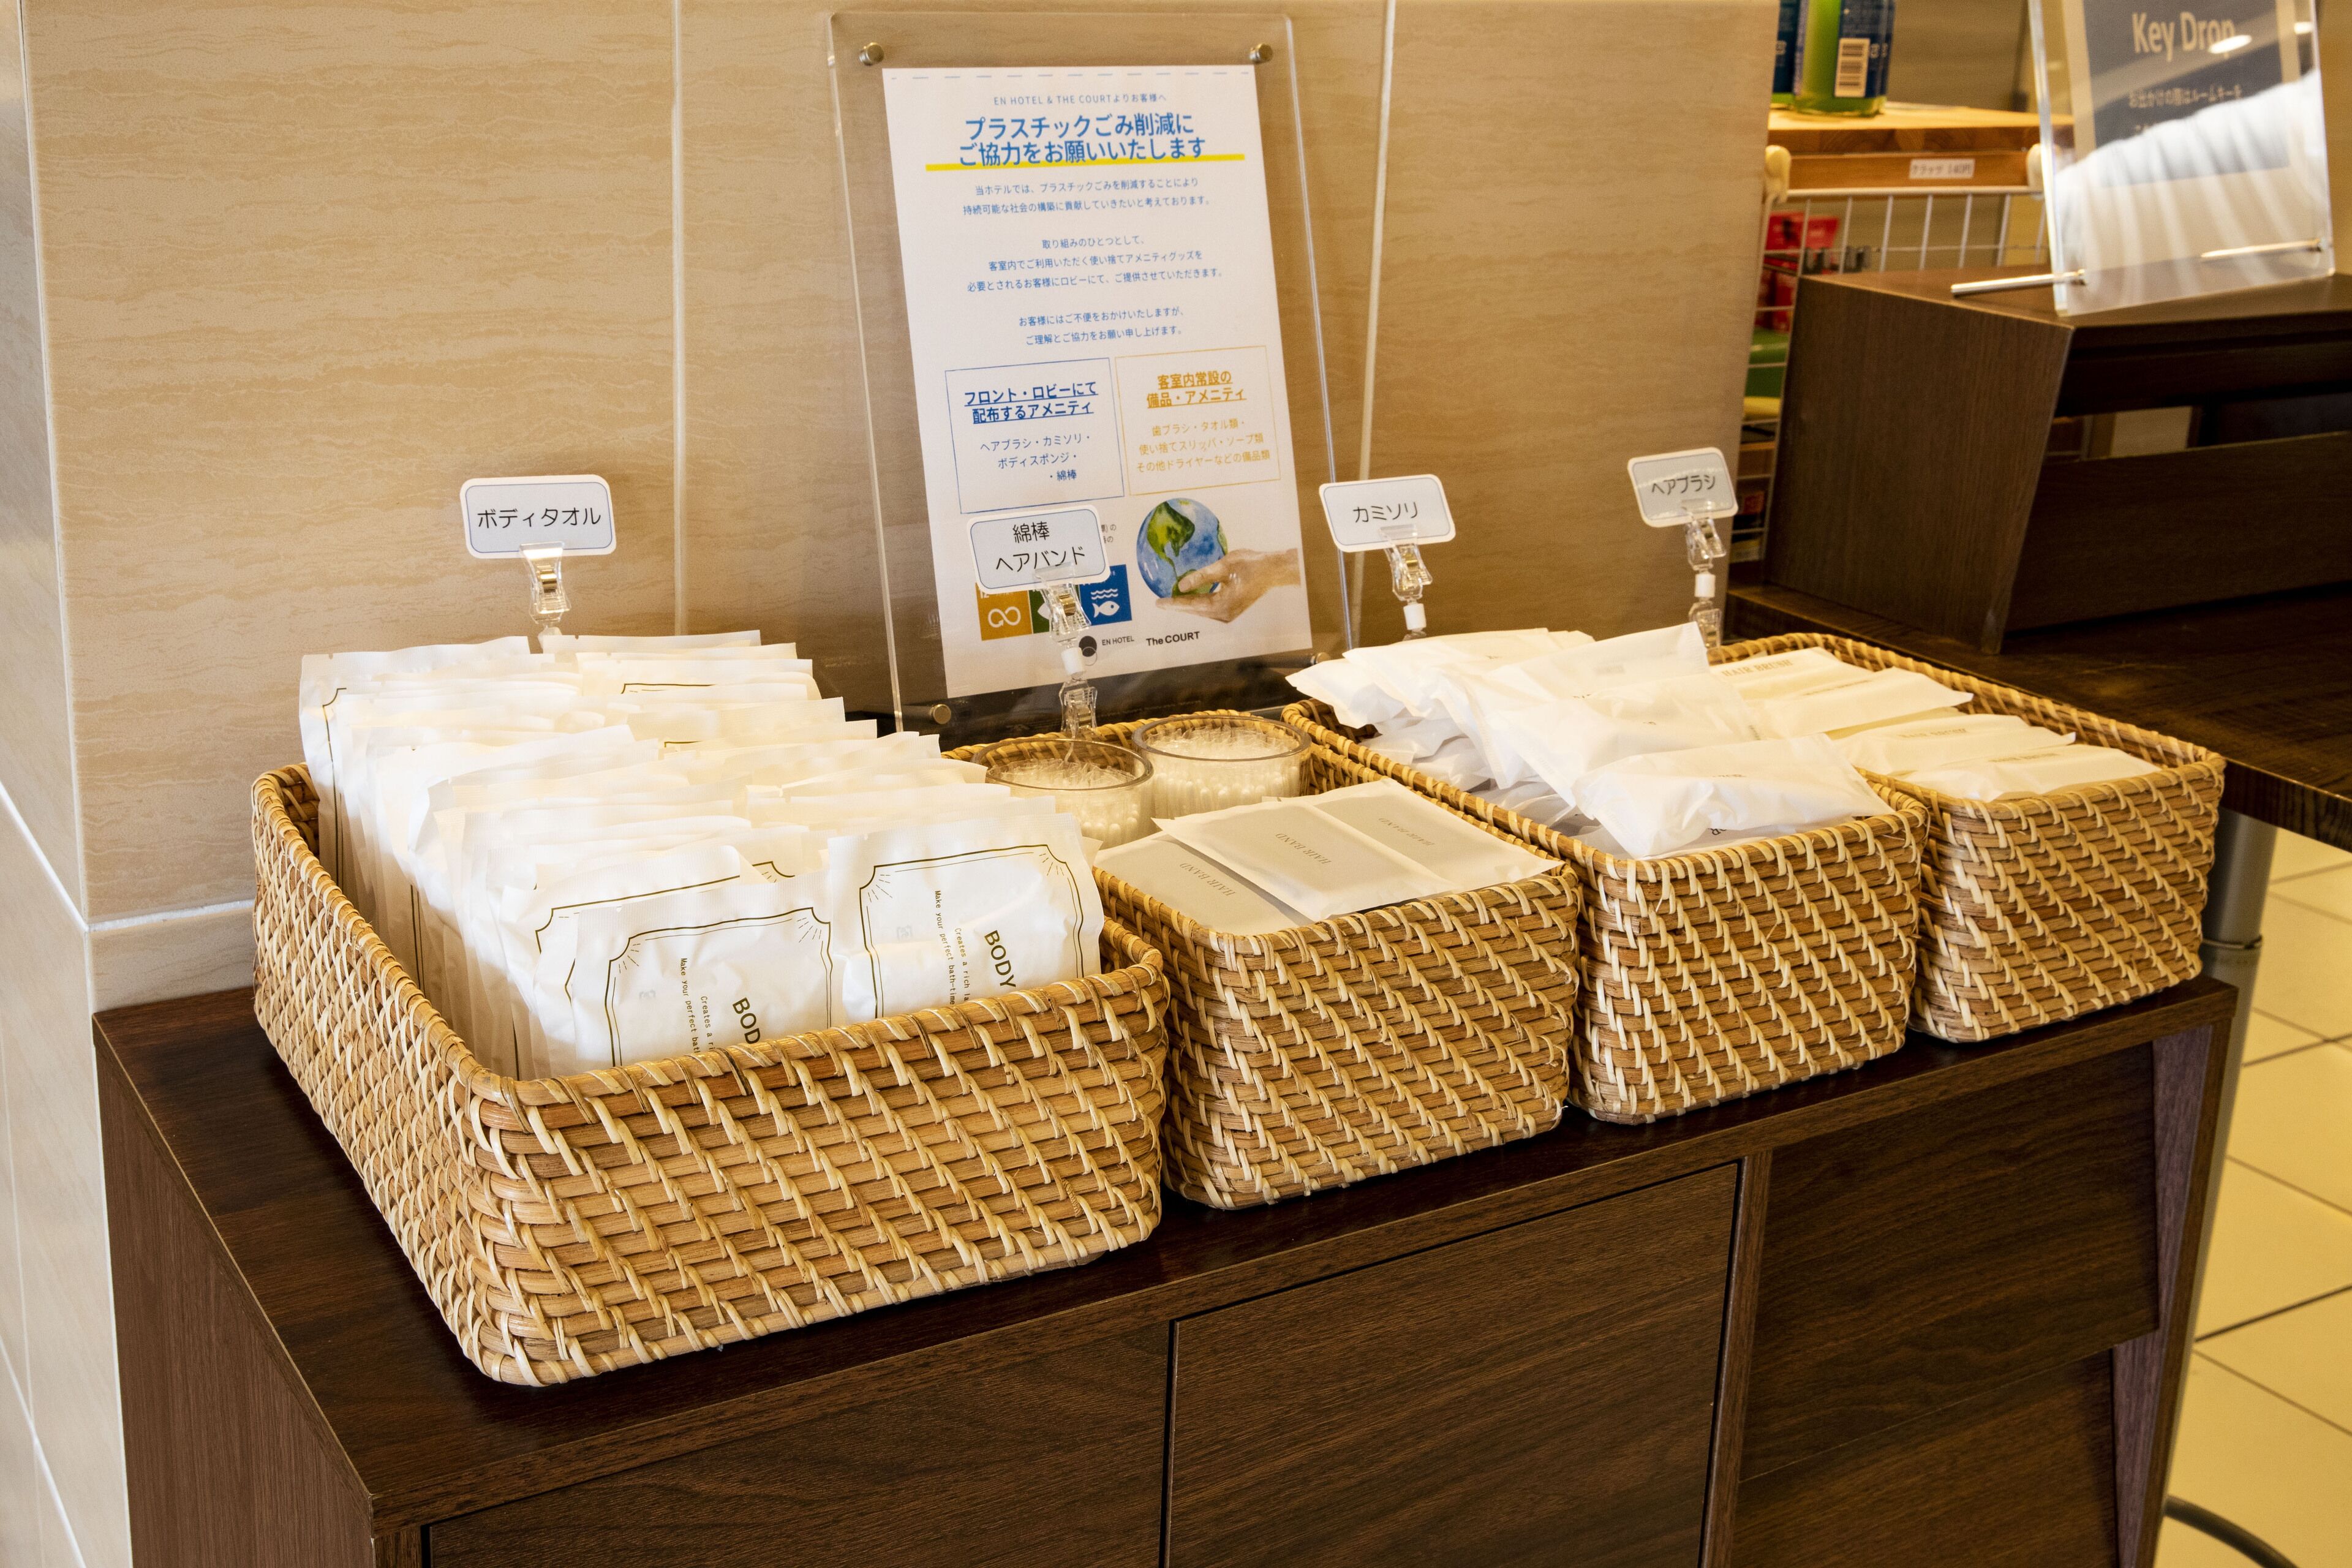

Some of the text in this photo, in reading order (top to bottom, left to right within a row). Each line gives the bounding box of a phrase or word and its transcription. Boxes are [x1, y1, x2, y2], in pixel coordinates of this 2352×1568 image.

[2132, 12, 2174, 62] Key
[993, 97, 1006, 105] EN
[1011, 96, 1043, 105] HOTEL
[1047, 96, 1054, 105] &
[1057, 95, 1076, 104] THE
[965, 113, 1194, 141] プラスチックごみ削減に
[959, 137, 1206, 167] ご協力をお願いいたします
[975, 178, 1198, 196] 当ホテルでは、プラスチックごみを削減することにより
[962, 196, 1211, 216] 持続可能な社会の構築に貢献していきたいと考えております。
[1042, 236, 1145, 249] 取り組みのひとつとして、
[989, 251, 1202, 271] 客室内でご利用いただく使い捨てアメニティグッズを
[967, 269, 1222, 292] 必要とされるお客様にロビーにて、ご提供させていただきます。
[1019, 307, 1185, 327] お客様にはご不便をおかけいたしますが、
[1026, 326, 1182, 345] ご理解とご協力をお願い申し上げます。
[1158, 370, 1232, 389] 客室内常設の
[965, 382, 1098, 405] フロント・ロビーにて
[1147, 387, 1247, 407] 備品・アメニティ
[973, 401, 1093, 424] 配布するアメニティ
[1652, 474, 1716, 496] ヘアブラシ
[477, 507, 601, 529] ボディタオル
[1352, 502, 1418, 523] カミソリ
[1012, 521, 1050, 543] 綿棒
[996, 546, 1085, 572] ヘアバンド
[1112, 636, 1134, 644] HOTEL
[1146, 631, 1200, 646] The COURT
[1275, 833, 1306, 850] BAND
[1180, 863, 1235, 895] HAIR BAND
[954, 928, 967, 957] Creates
[939, 933, 954, 960] perfect
[949, 965, 957, 1005] bath-time
[984, 930, 1016, 988] BODY
[685, 1000, 697, 1032] perfect
[700, 996, 711, 1028] Creates
